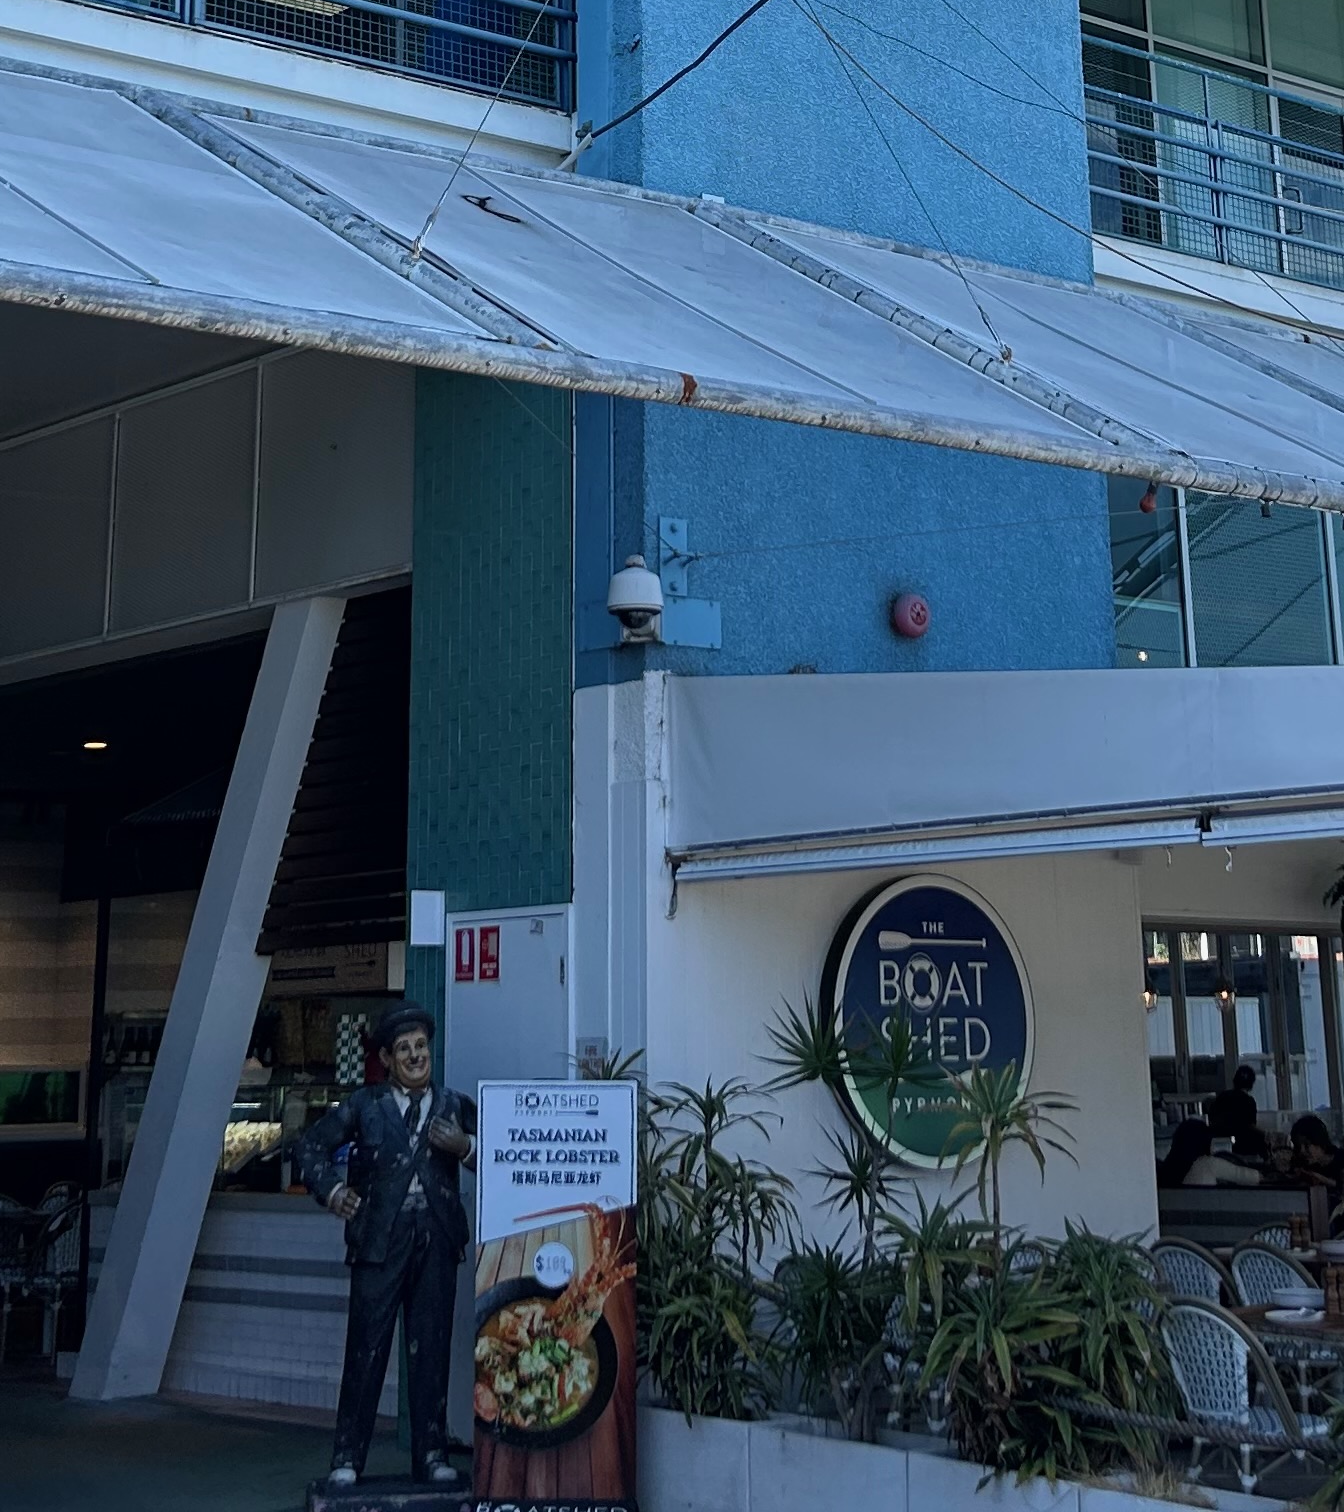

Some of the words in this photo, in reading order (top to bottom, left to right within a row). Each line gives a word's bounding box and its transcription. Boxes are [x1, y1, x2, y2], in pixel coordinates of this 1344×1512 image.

[921, 921, 945, 934] THE
[878, 952, 989, 1013] BOAT
[514, 1092, 600, 1109] BOATSHED
[892, 1096, 981, 1114] PYRMON
[507, 1128, 608, 1144] TASMANIAN
[494, 1149, 542, 1164] ROCK
[546, 1149, 621, 1165] LOBSTER
[512, 1170, 602, 1186] 塔斯马尼亚龙虾
